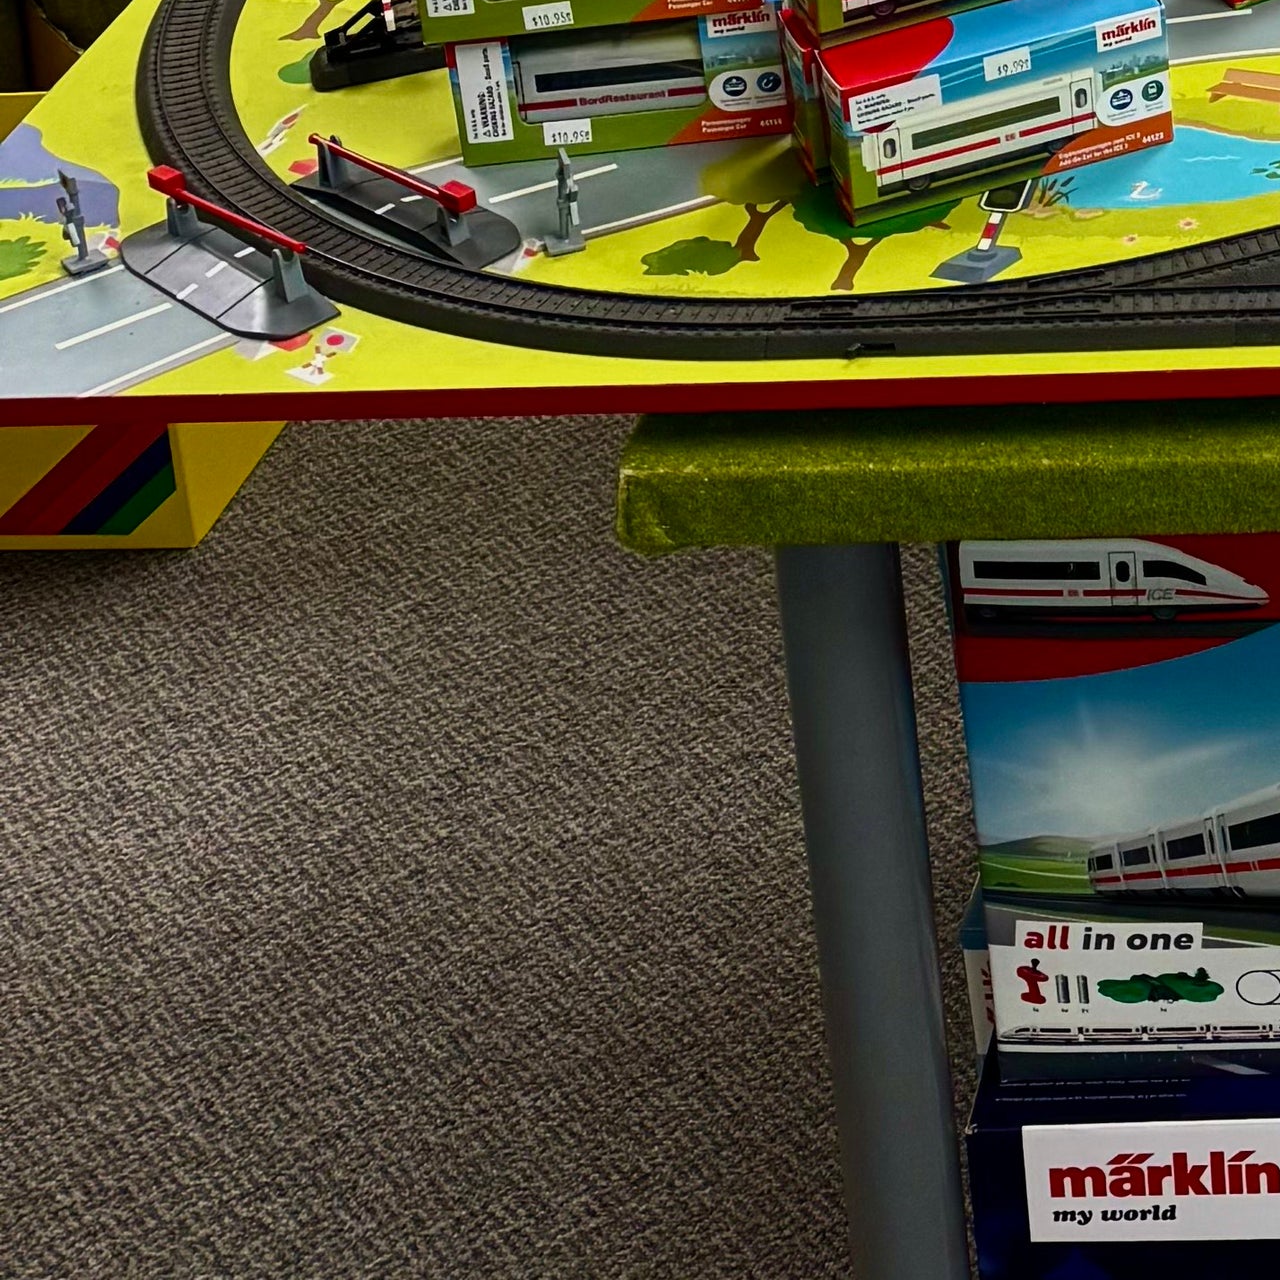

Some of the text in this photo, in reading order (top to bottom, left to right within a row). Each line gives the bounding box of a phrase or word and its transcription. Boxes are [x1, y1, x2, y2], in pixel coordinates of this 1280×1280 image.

[579, 90, 666, 107] BordRestaurant
[1146, 587, 1175, 602] ICE
[1024, 927, 1194, 950] all in one
[1052, 1203, 1178, 1228] my world
